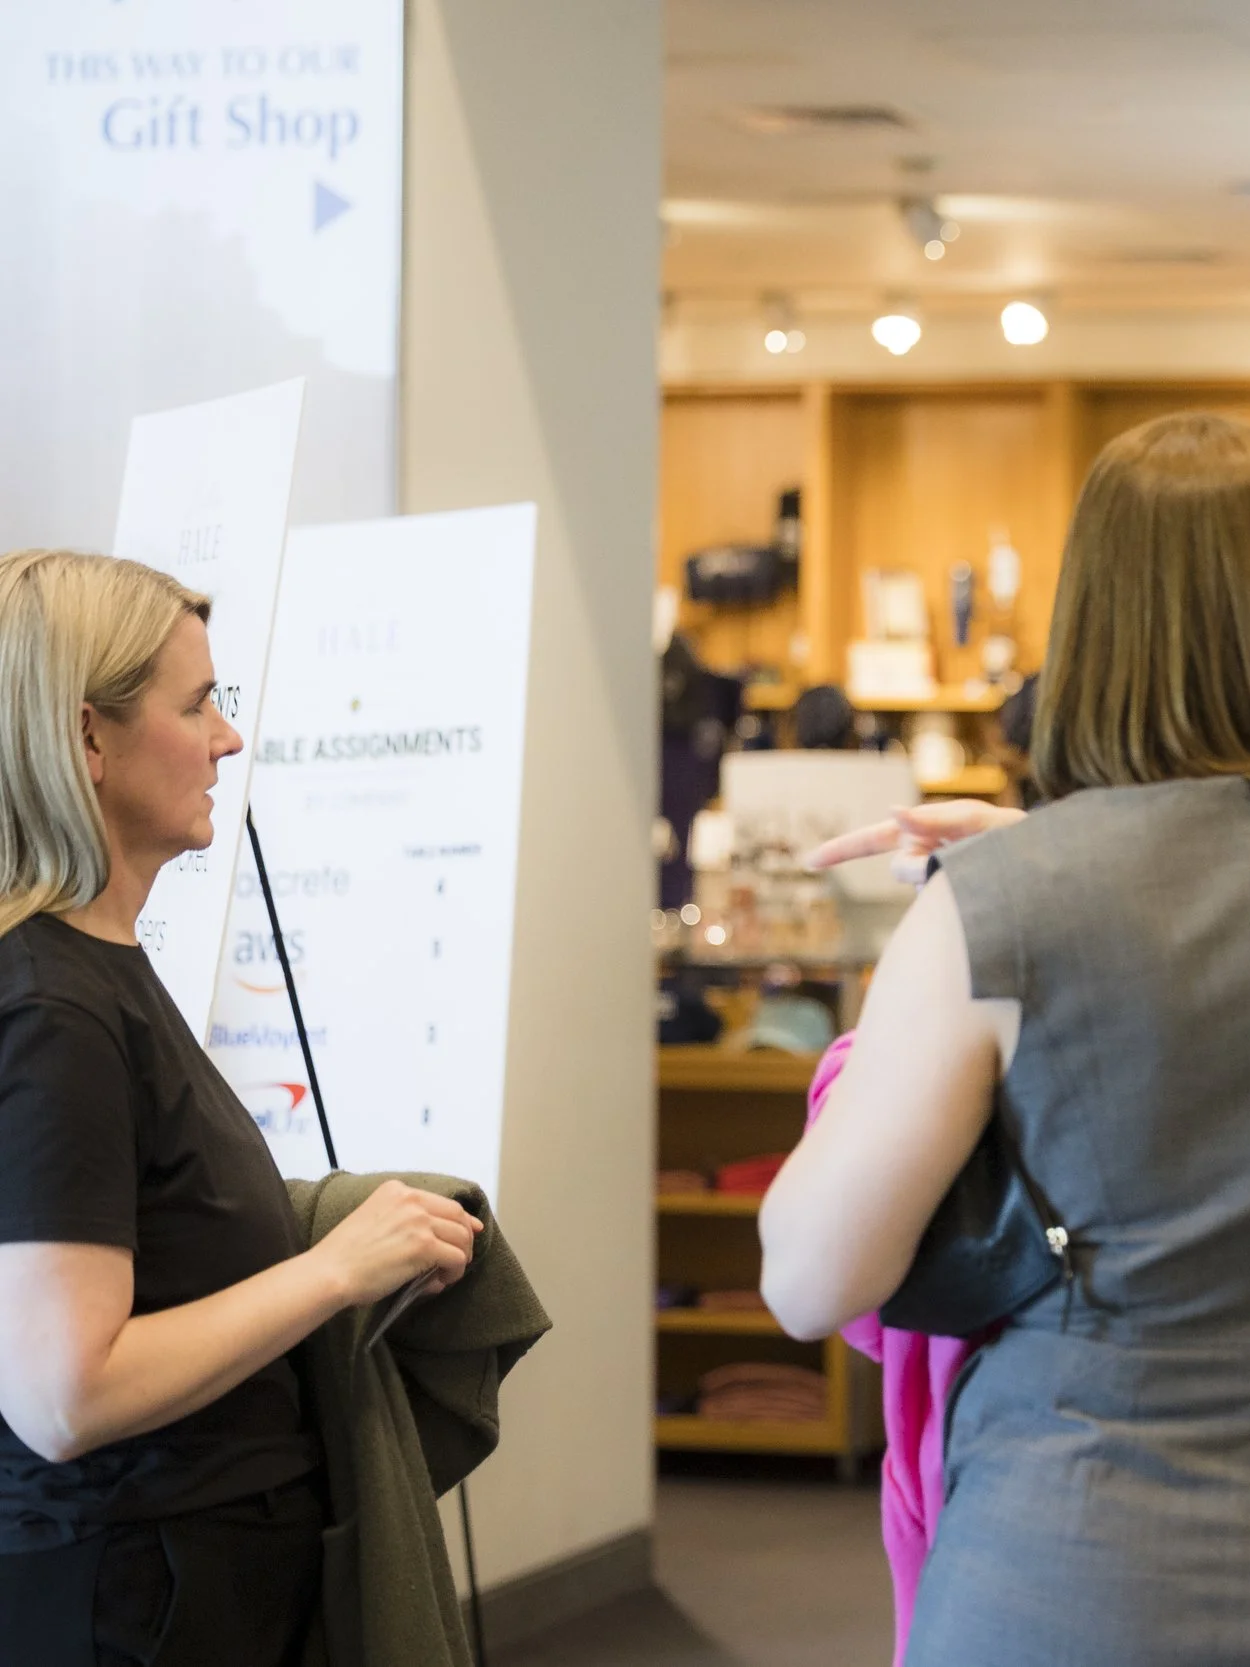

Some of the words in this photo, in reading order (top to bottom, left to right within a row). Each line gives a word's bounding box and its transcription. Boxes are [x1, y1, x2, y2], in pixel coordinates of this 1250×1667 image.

[44, 47, 119, 84] THIS
[130, 47, 207, 81] WAY
[220, 44, 268, 78] TO
[278, 41, 362, 76] OUR
[99, 93, 204, 153] Gift
[225, 91, 363, 162] Shop
[255, 735, 306, 766] BLE
[313, 725, 484, 762] ASSIGNMENTS
